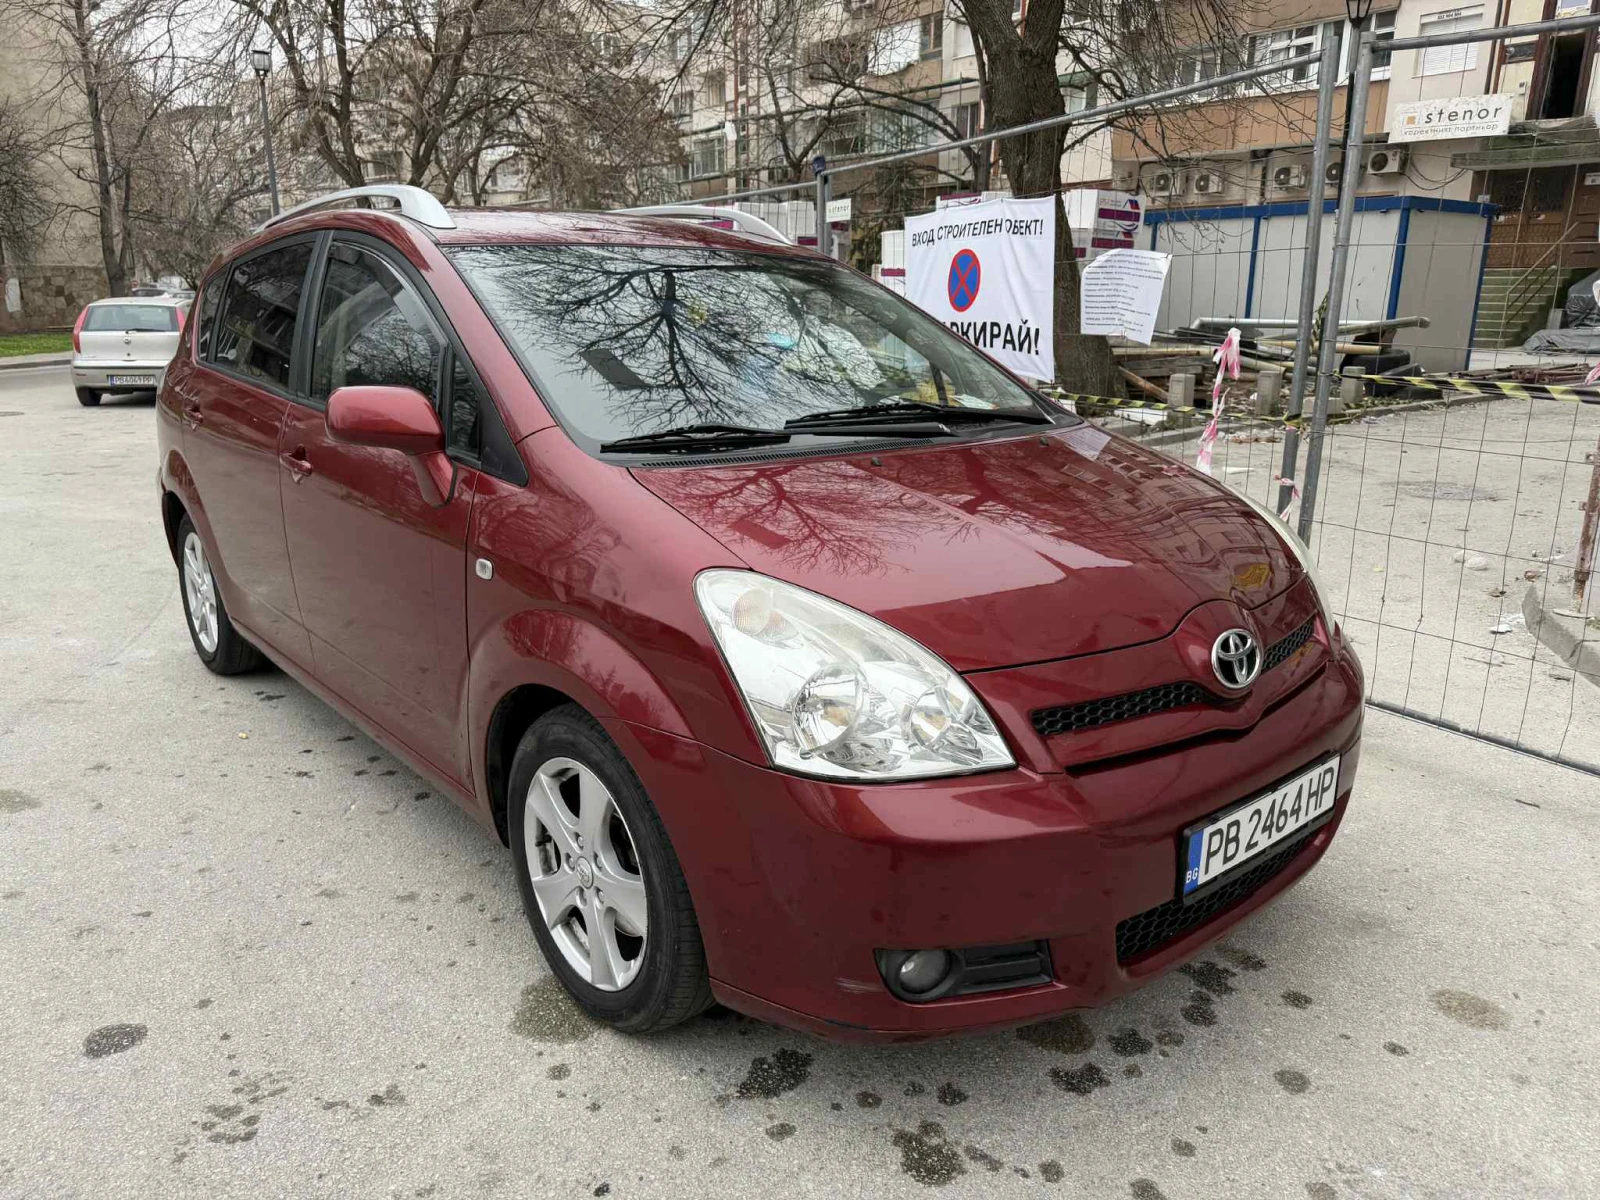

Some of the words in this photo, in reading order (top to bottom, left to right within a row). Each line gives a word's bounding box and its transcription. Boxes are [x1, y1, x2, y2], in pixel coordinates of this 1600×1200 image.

[1425, 106, 1502, 124] stenor
[1454, 124, 1498, 133] партньор
[912, 228, 935, 247] ВХОД
[937, 218, 1003, 241] СТРОИТЕЛЕН
[1005, 219, 1044, 236] ОБЕКТ!
[1204, 819, 1241, 875] PB
[1245, 783, 1303, 853] 2464
[1305, 766, 1335, 818] HP
[1185, 867, 1199, 884] BG
